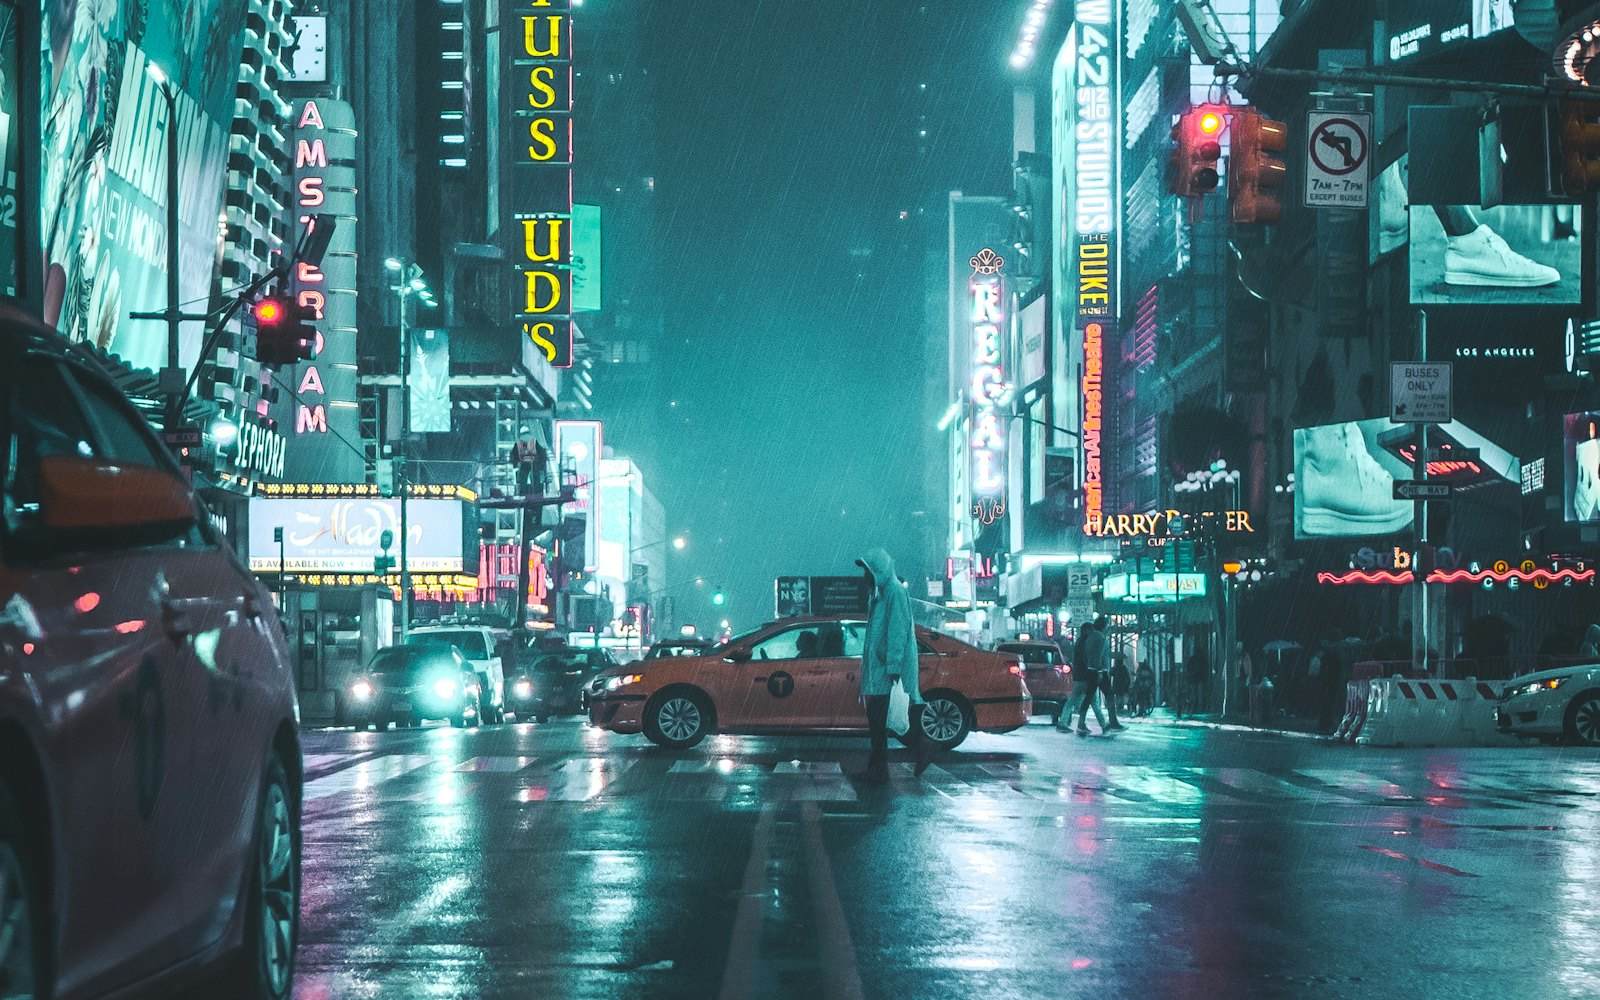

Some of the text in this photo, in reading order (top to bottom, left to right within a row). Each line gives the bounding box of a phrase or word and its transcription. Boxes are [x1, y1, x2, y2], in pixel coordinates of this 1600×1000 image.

[1079, 25, 1109, 86] 42
[1076, 121, 1111, 233] STUDIOS
[1311, 179, 1332, 191] 7AM
[1342, 180, 1363, 193] 7PM
[1310, 193, 1363, 202] EXCEPT BUSES
[1080, 233, 1109, 242] THE
[1079, 243, 1109, 306] DUKE
[1456, 347, 1535, 357] LOS ANGELES
[1405, 367, 1440, 378] BUSES
[968, 283, 1005, 489] REGAL
[1407, 380, 1435, 391] ONLY
[235, 407, 287, 479] SEPHORA
[1402, 486, 1420, 496] ONE
[1427, 486, 1446, 496] WAY
[1083, 508, 1255, 538] HARRY PER
[266, 559, 319, 568] AVILABLE
[322, 559, 345, 568] NOW
[1471, 561, 1480, 573] A
[1552, 561, 1558, 571] 1
[1576, 561, 1585, 572] 3
[1071, 574, 1089, 586] 25
[1483, 577, 1494, 588] C
[1510, 577, 1519, 588] E
[1563, 576, 1572, 587] 2
